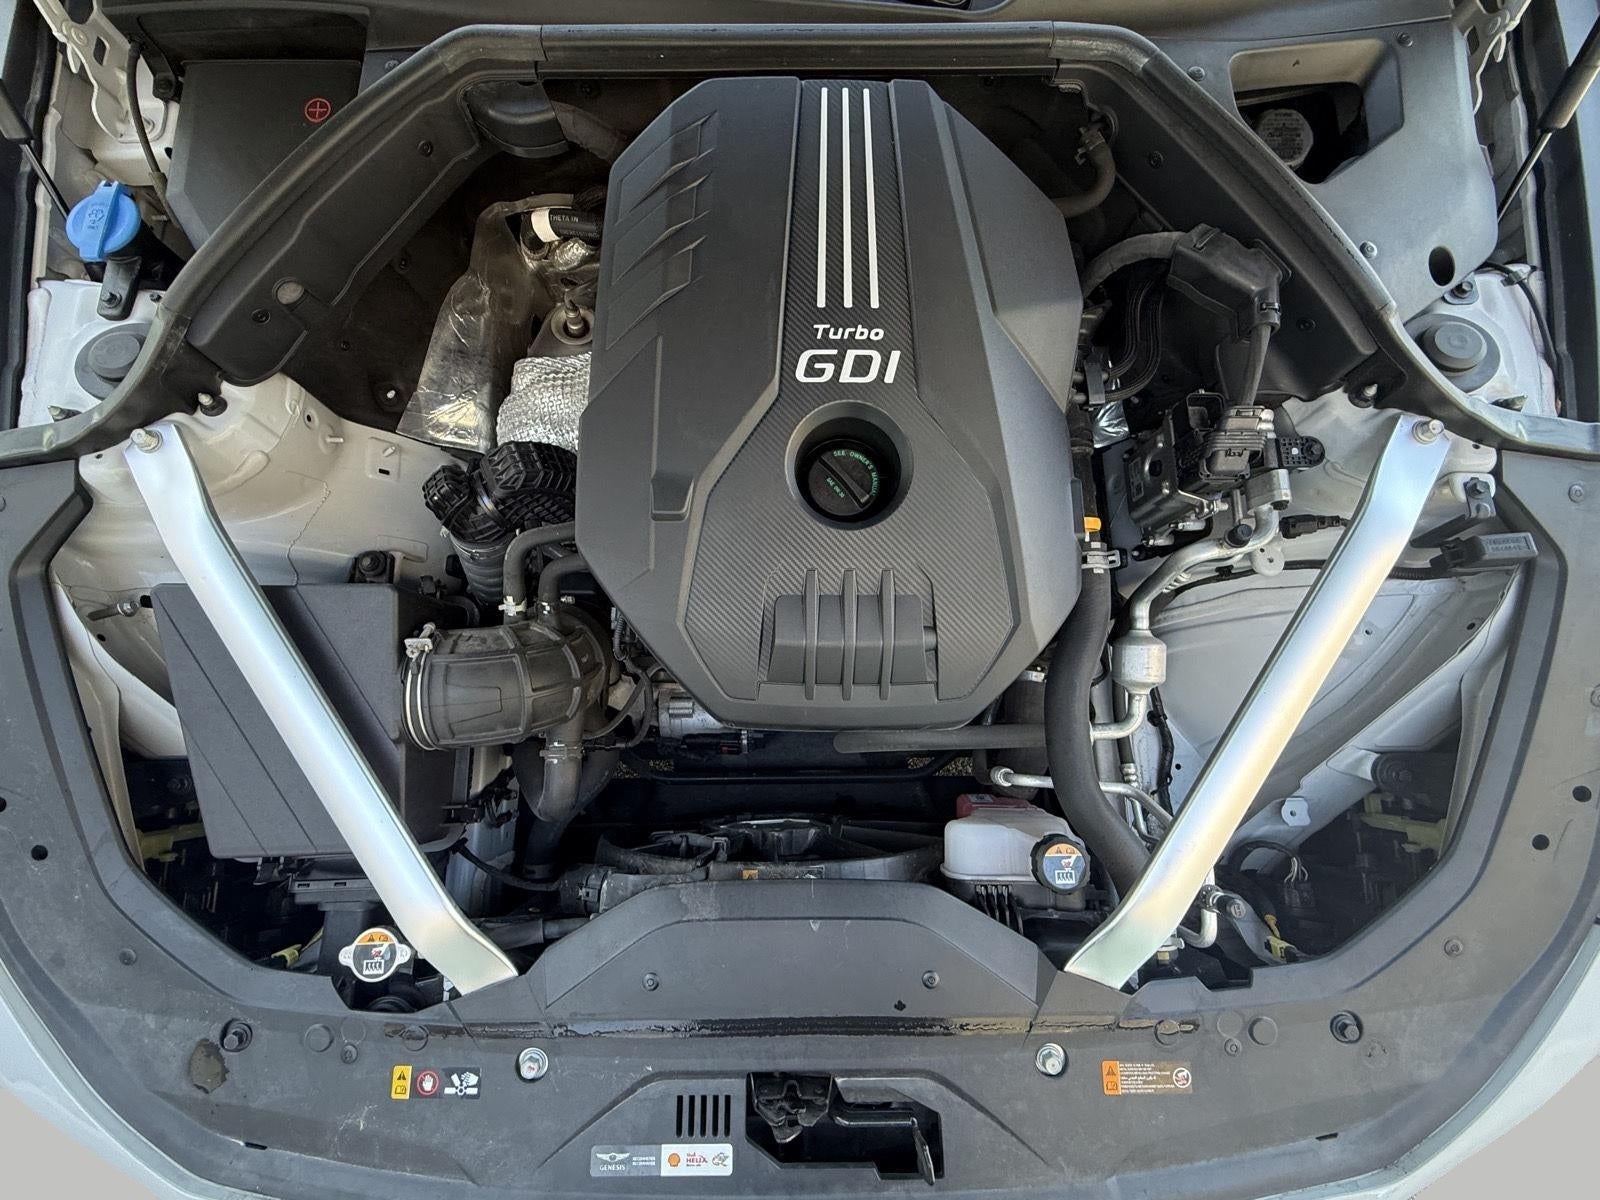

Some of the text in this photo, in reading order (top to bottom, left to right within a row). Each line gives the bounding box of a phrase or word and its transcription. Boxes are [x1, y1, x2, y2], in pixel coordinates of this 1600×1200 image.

[813, 324, 884, 340] Turbo
[795, 349, 901, 384] GDI
[849, 451, 874, 470] OWNER'S
[686, 1155, 708, 1164] HELIX
